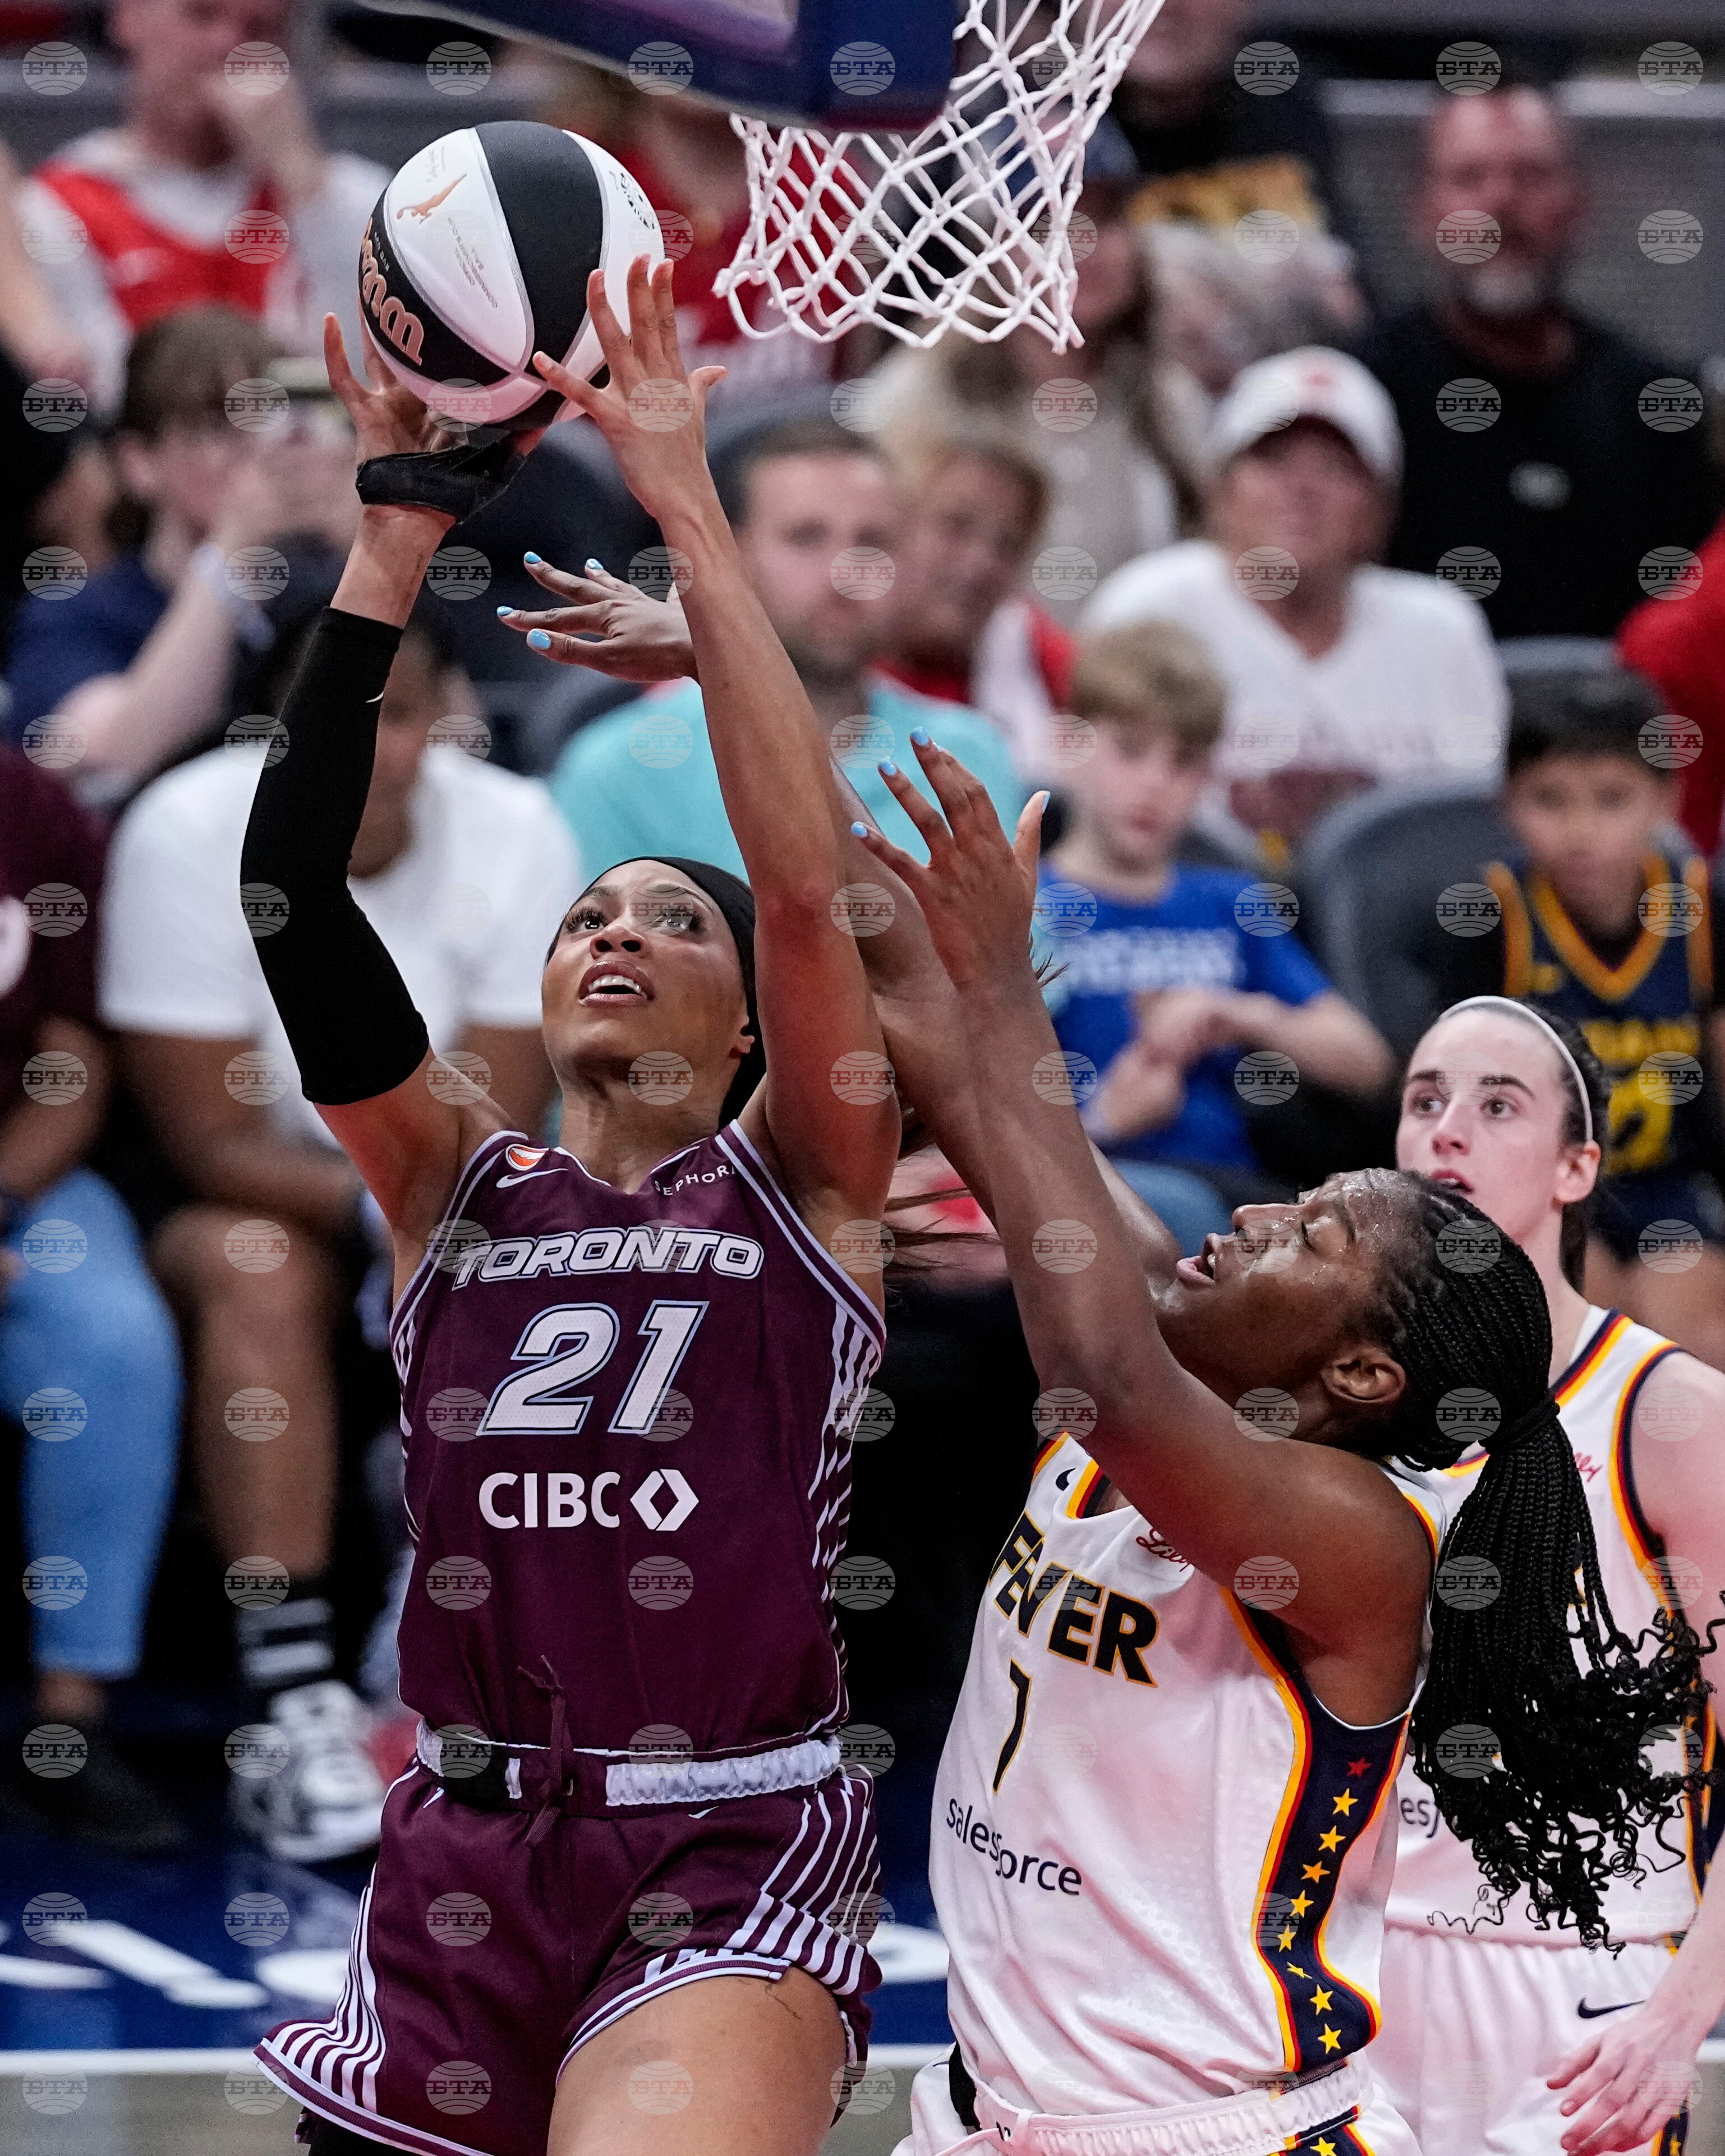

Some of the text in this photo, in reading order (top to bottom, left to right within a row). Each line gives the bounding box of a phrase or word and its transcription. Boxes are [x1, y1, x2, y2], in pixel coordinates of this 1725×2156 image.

[452, 1227, 765, 1291] TORONTO
[476, 1300, 710, 1436] 21
[479, 1471, 621, 1530] CIBC
[988, 1510, 1159, 1688] FEVER
[992, 1657, 1033, 1795] 1
